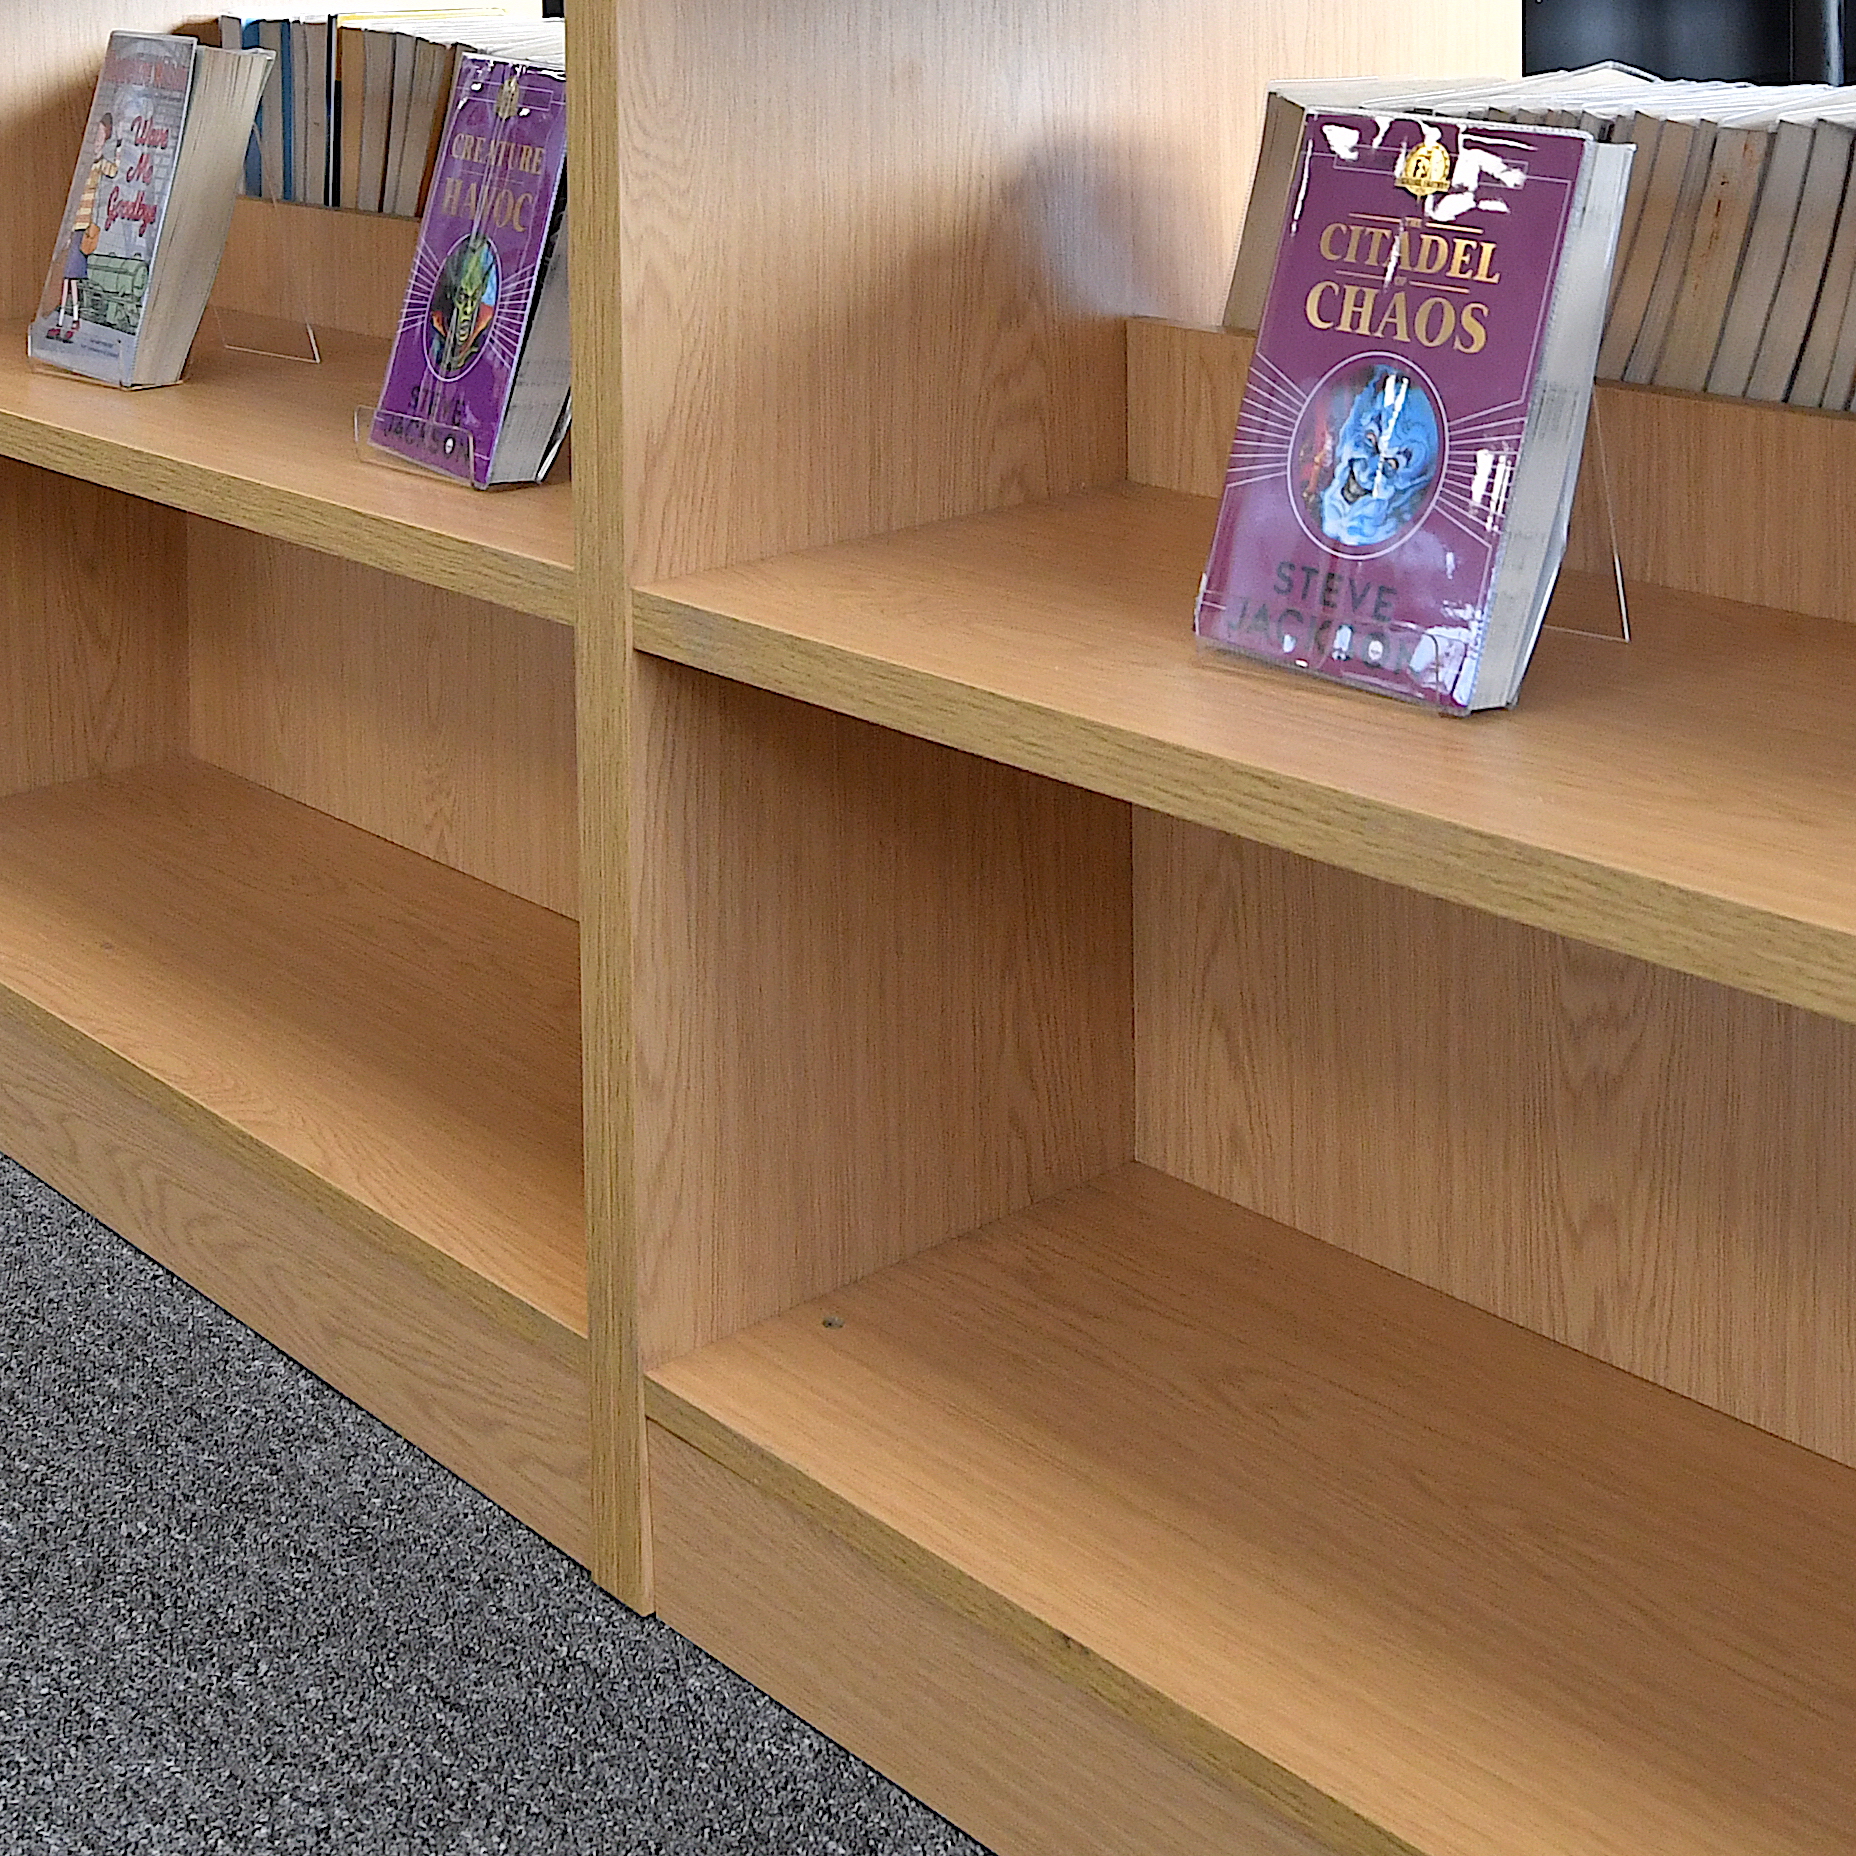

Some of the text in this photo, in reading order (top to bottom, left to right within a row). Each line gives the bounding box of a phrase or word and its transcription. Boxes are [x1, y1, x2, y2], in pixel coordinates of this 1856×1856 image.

[451, 133, 546, 176] CREATURE
[1319, 222, 1502, 285] CITADEL
[1304, 279, 1490, 355] CHAOS
[1273, 560, 1398, 623] STEVE
[1226, 597, 1421, 678] JACKON
